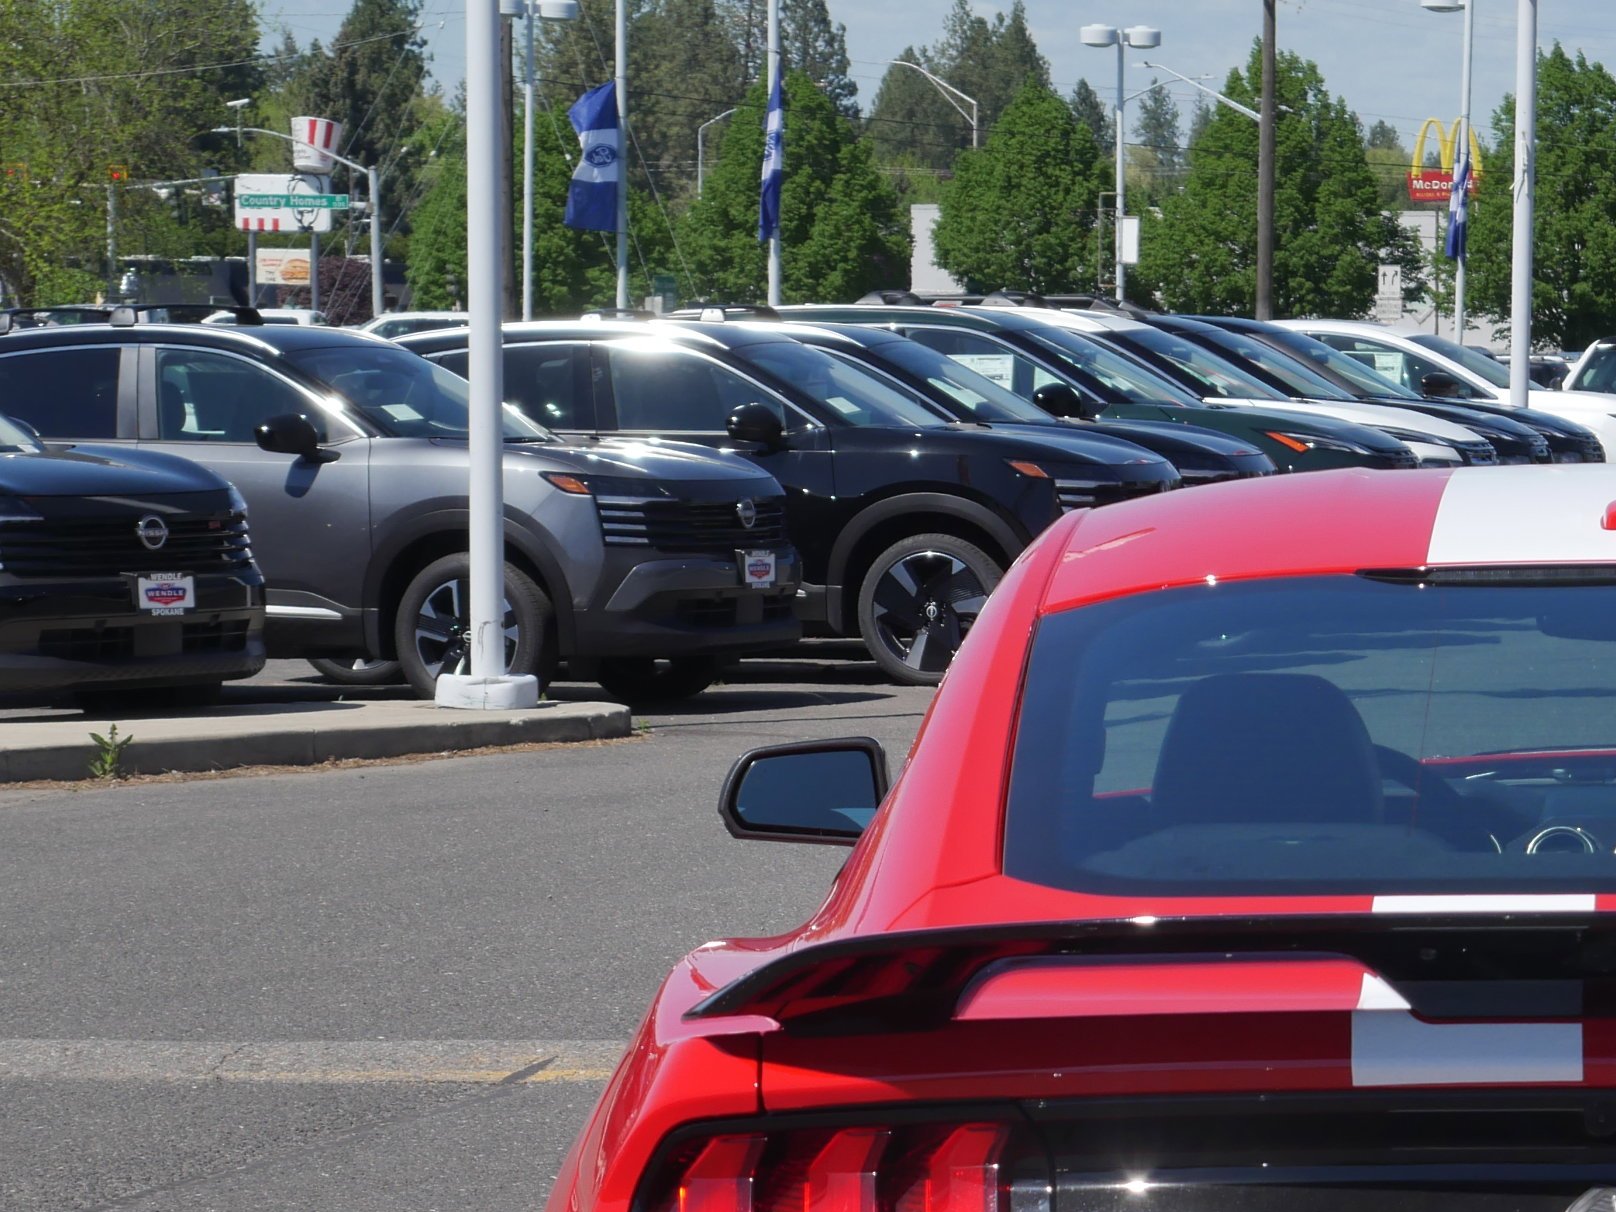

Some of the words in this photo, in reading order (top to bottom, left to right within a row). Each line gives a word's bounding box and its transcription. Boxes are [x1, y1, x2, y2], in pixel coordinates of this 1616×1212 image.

[241, 195, 286, 207] Country
[290, 195, 328, 206] Homes
[150, 572, 183, 580] WENDLE
[151, 608, 185, 616] SPOKANE
